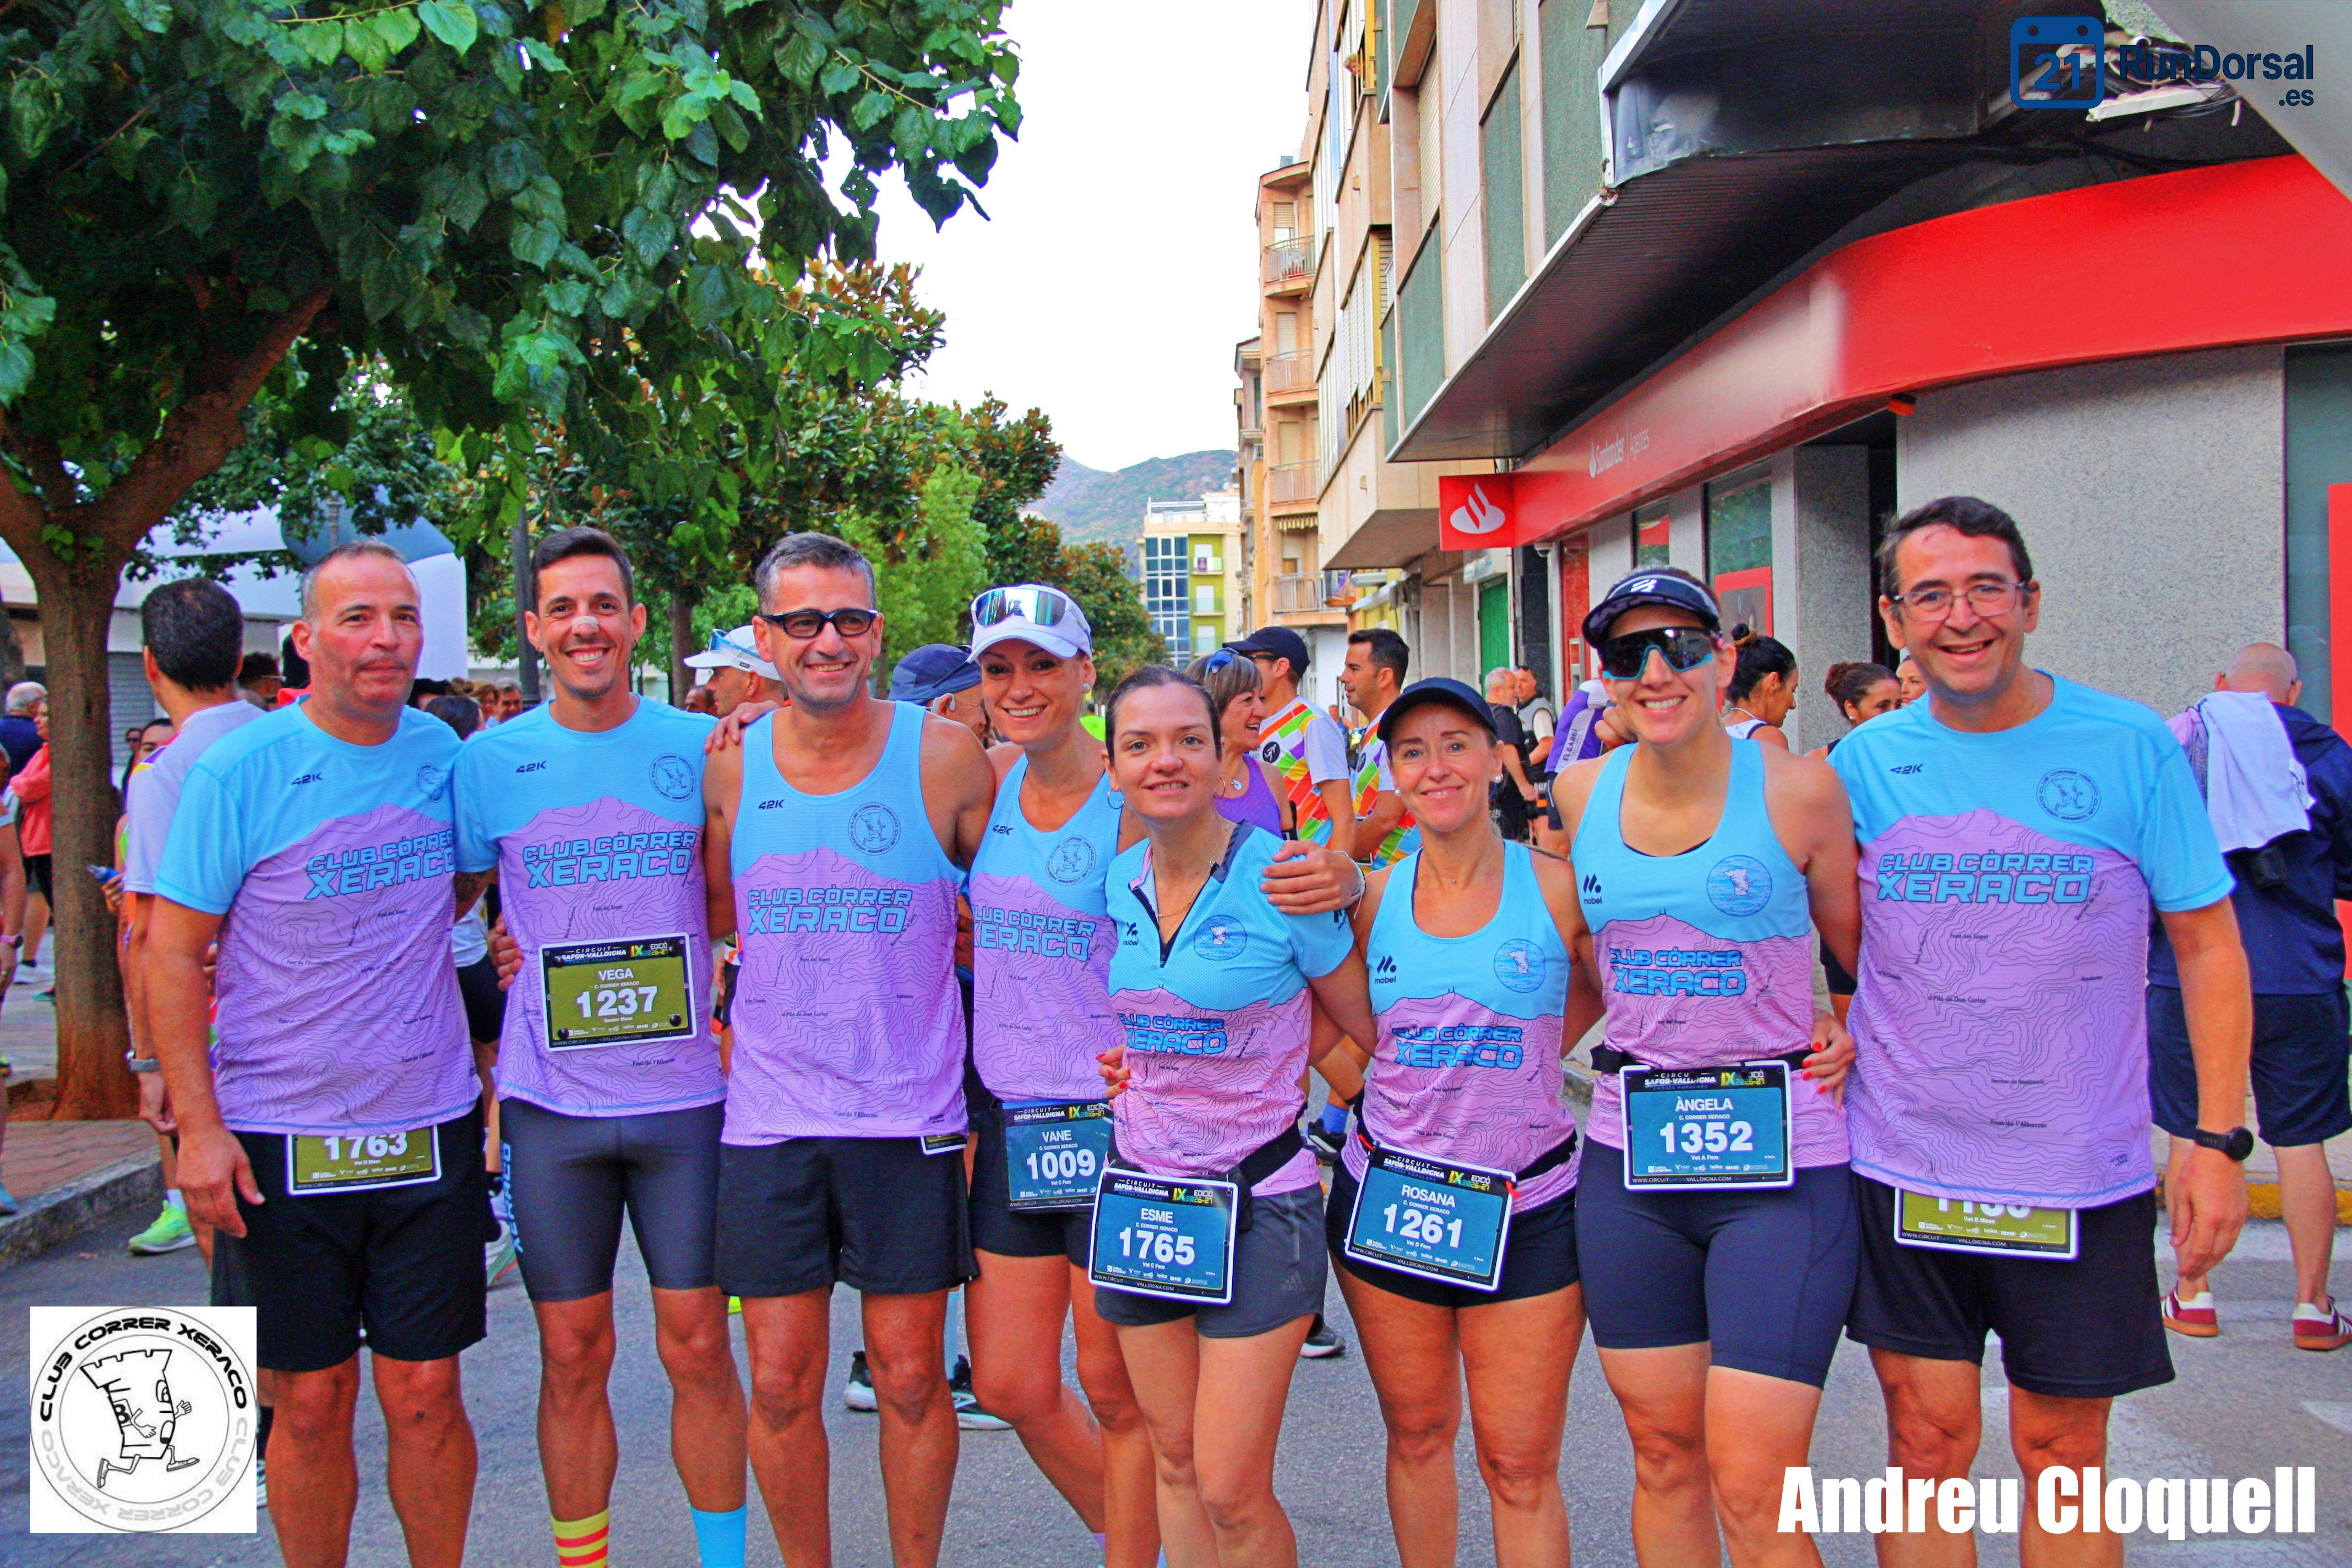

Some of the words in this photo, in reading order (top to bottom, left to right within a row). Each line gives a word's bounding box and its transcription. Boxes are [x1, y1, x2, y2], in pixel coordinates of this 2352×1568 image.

[1596, 433, 1625, 474] Santander
[515, 760, 547, 774] 42K
[1890, 763, 1924, 775] 42K
[291, 772, 324, 786] 42K
[758, 799, 785, 810] 42K
[992, 824, 1014, 835] 42K
[523, 840, 590, 862] CLUB
[595, 831, 697, 855] CÒRRER
[307, 847, 377, 872] CLUB
[1878, 853, 1954, 872] CLUB
[1958, 850, 2094, 873] CÒRRER
[304, 846, 455, 900] XERACO
[524, 848, 692, 889] XERACO
[748, 888, 804, 907] CLUB
[807, 884, 912, 906] CÒRRER
[1876, 872, 2092, 904] XERACO
[1583, 896, 1603, 905] mobel
[747, 906, 907, 934] XERACO
[972, 905, 1005, 924] LUB
[1008, 908, 1096, 937] CÒRRER
[630, 945, 644, 957] IX
[1610, 948, 1652, 967] CLUB
[1654, 946, 1743, 967] CÒRRER
[598, 967, 634, 981] VEGA
[1374, 976, 1397, 984] mobel
[1611, 966, 1747, 997] XERACO
[576, 986, 658, 1018] 1237
[1392, 1026, 1438, 1041] CLUB
[1394, 1039, 1523, 1070] XERACO
[1721, 1072, 1736, 1086] IX
[1675, 1096, 1734, 1112] ÀNGELA
[1014, 1110, 1065, 1120] SAFOR-VALLDIGNA
[1069, 1106, 1081, 1119] IX
[1042, 1130, 1072, 1142] VANE
[1659, 1121, 1754, 1153] 1352
[324, 1131, 408, 1161] 1763
[1026, 1148, 1096, 1179] 1009
[1384, 1158, 1445, 1179] SAFOR-VALLDIGNA
[1397, 1156, 1430, 1169] CIRCUIT
[1126, 1179, 1156, 1188] CIRCUIT
[1448, 1170, 1464, 1185] IX
[1114, 1182, 1169, 1197] SAFOR-VALLDIGNA
[1172, 1188, 1186, 1201] IX
[1401, 1184, 1456, 1208] ROSANA
[1141, 1208, 1173, 1223] ESME
[1409, 1201, 1429, 1210] CORRER
[1429, 1206, 1450, 1215] XERACO
[1383, 1203, 1463, 1248] 1261
[1119, 1227, 1195, 1265] 1765
